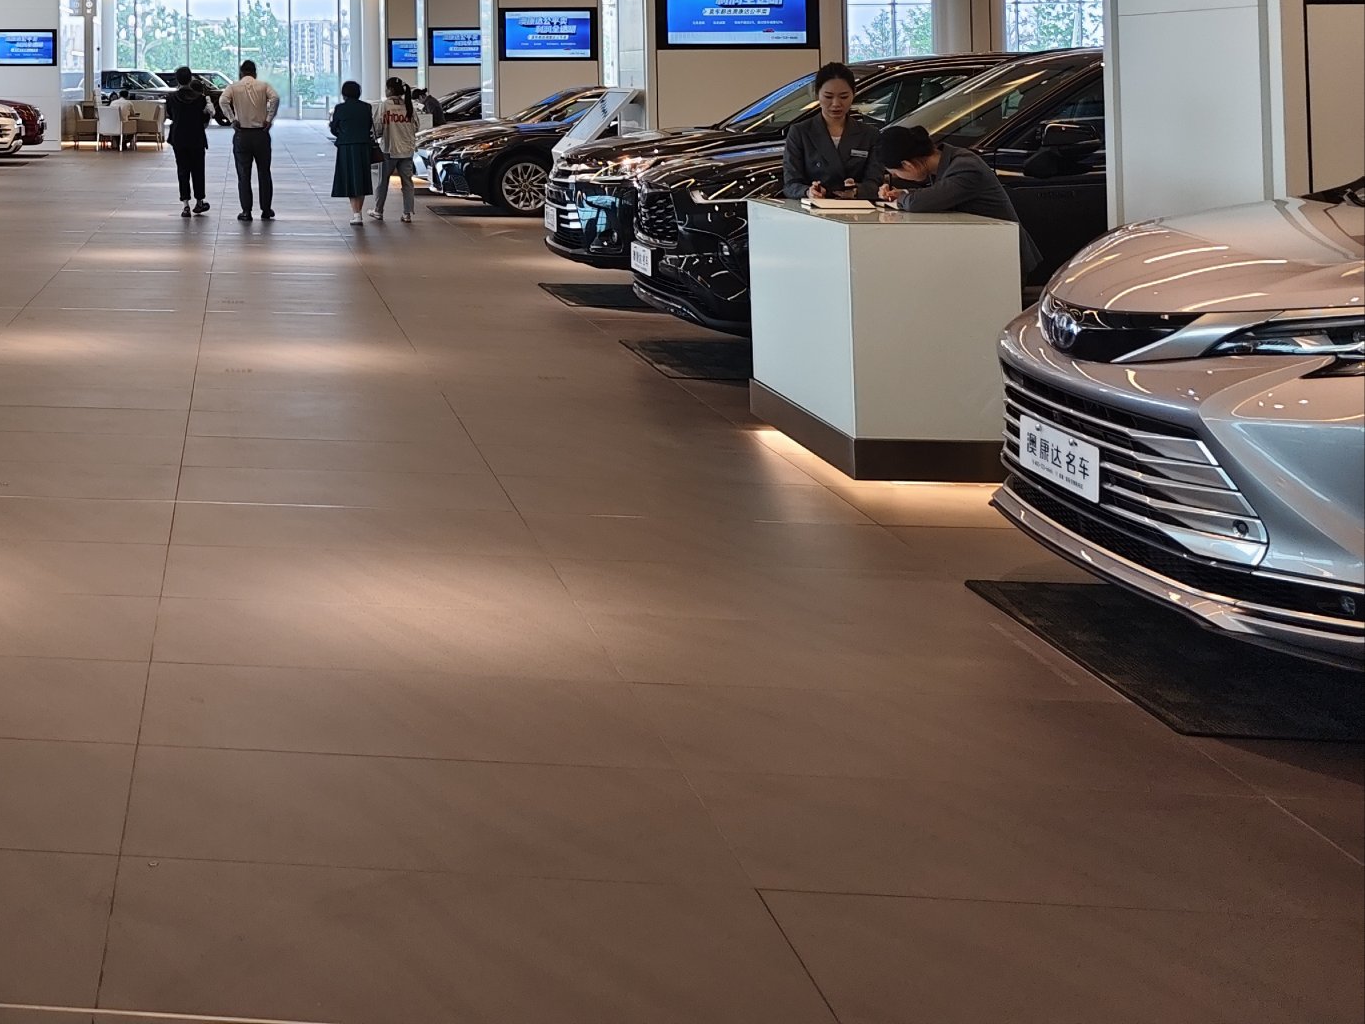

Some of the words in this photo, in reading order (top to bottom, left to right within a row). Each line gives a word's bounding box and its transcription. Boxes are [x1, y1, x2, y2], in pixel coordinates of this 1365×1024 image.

[1026, 431, 1090, 480] 澳康达名车
